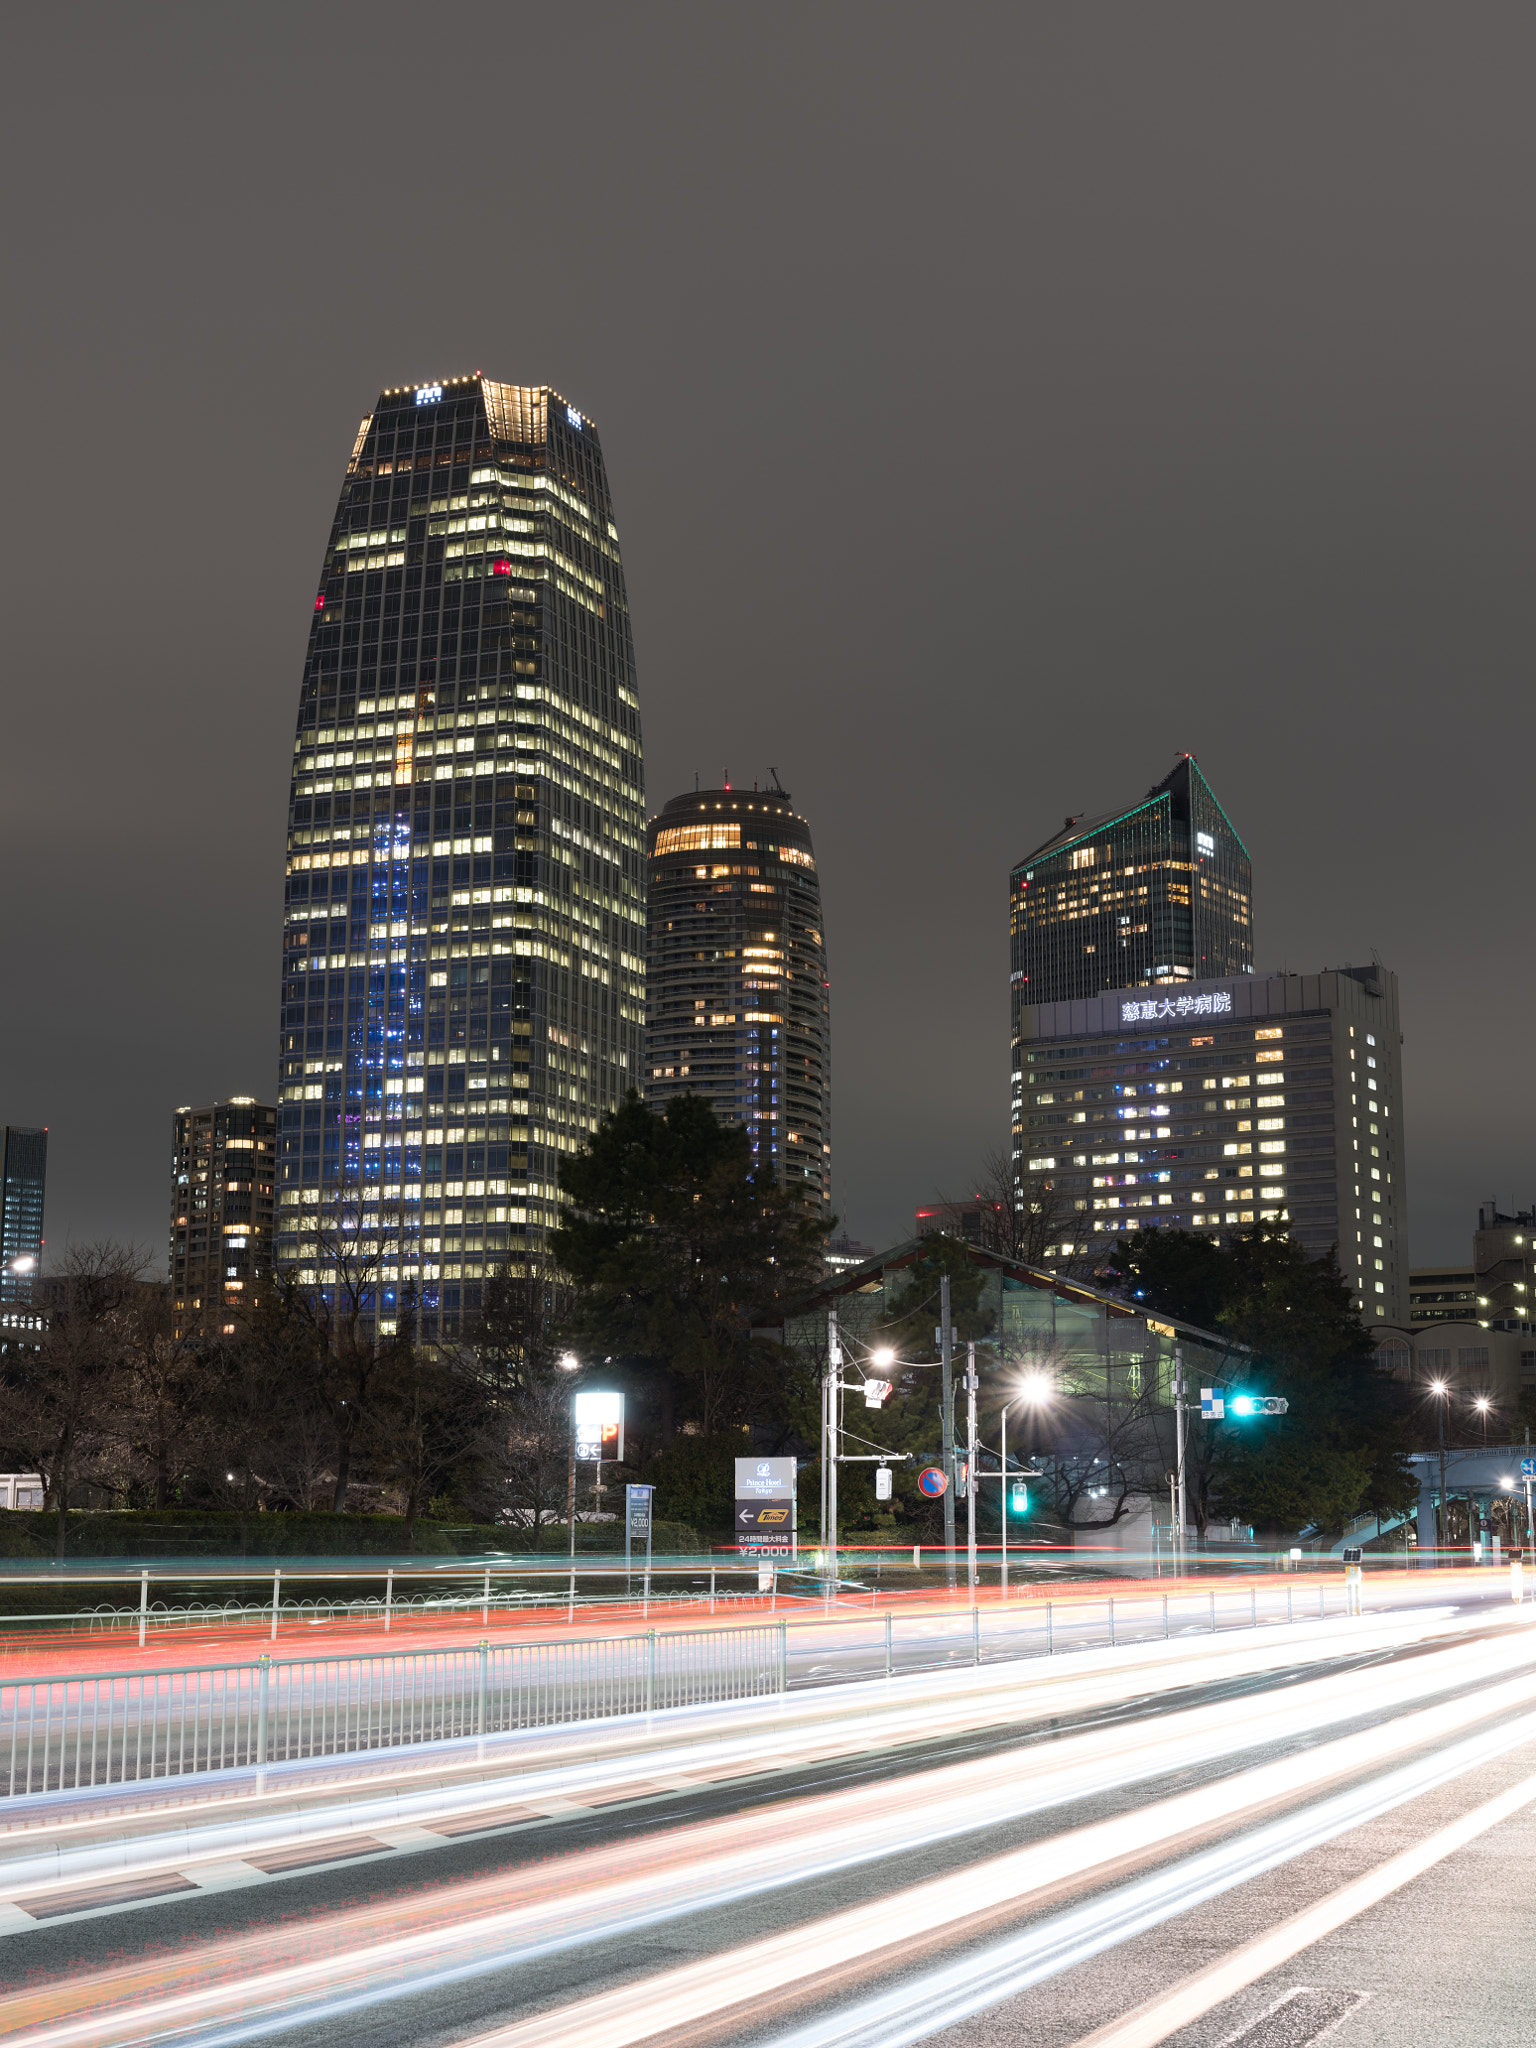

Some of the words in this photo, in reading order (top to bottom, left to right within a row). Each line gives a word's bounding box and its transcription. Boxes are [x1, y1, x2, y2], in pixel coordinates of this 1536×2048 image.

[602, 1424, 617, 1441] P
[766, 1478, 782, 1486] Hotel
[762, 1511, 786, 1521] Times
[739, 1546, 789, 1558] ¥2,000
